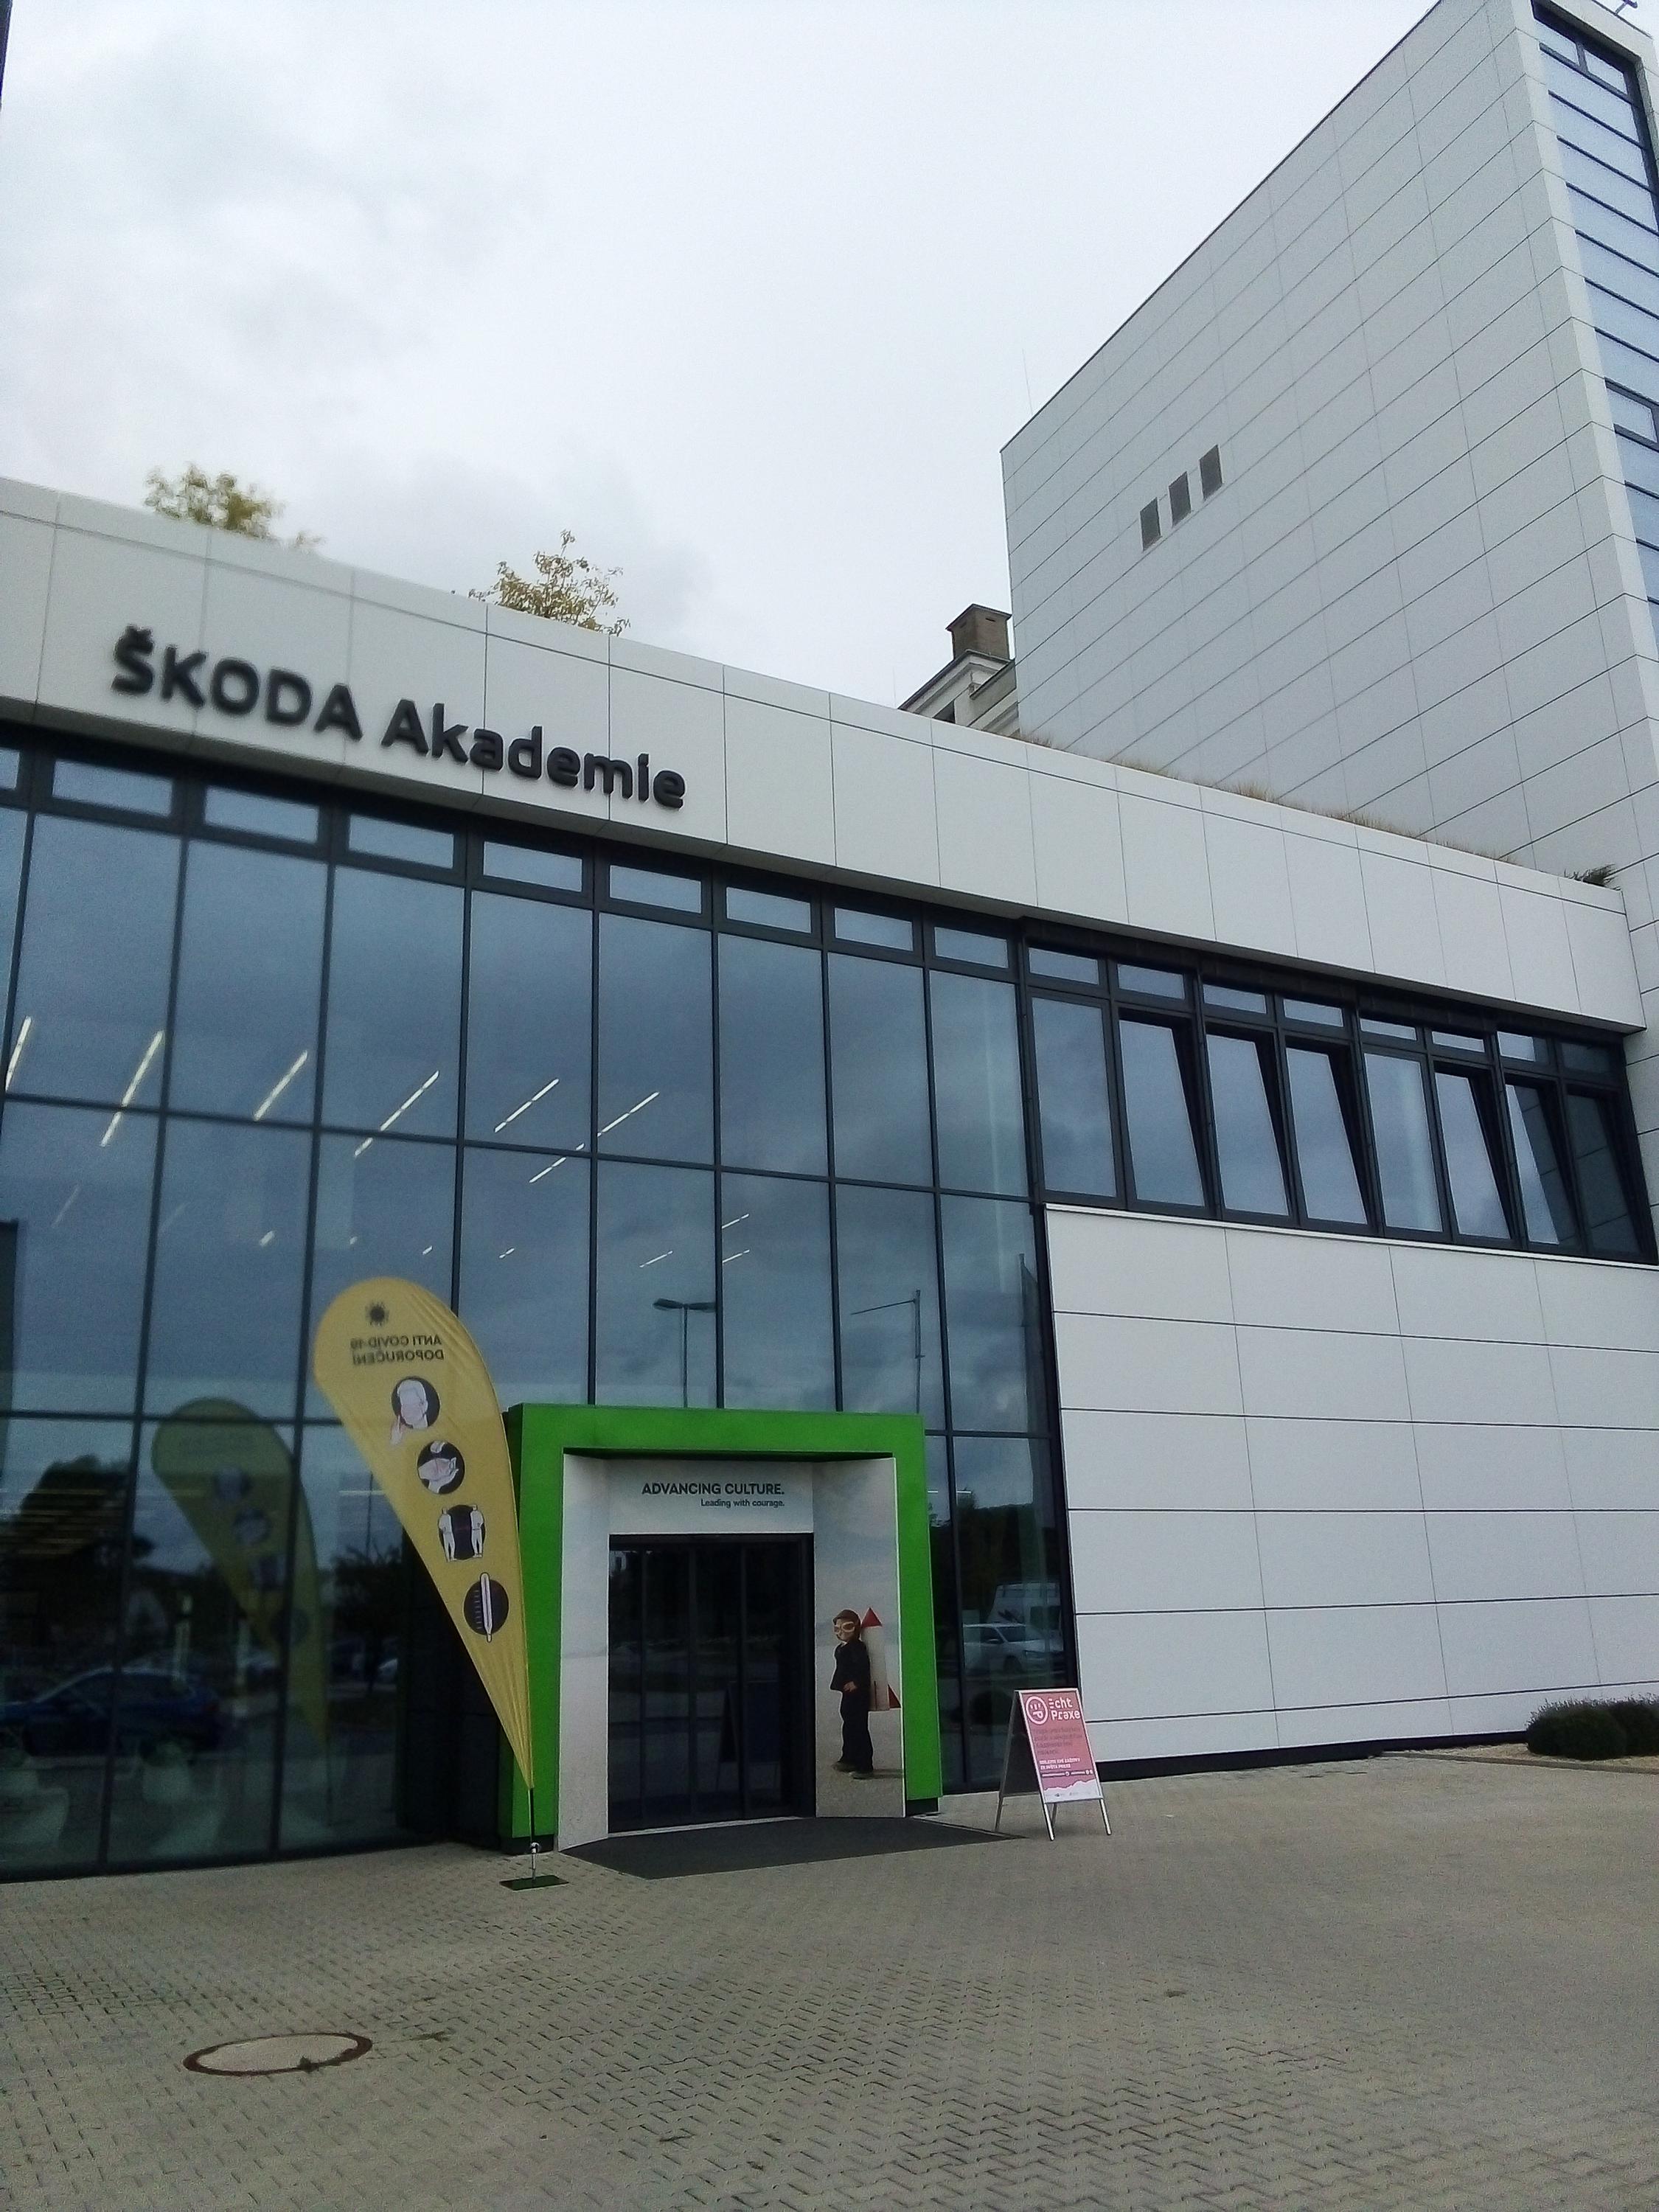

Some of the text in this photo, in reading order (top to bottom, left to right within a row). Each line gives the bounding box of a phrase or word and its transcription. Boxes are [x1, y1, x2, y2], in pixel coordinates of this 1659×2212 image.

[111, 625, 686, 810] ŠKODA Akademie
[641, 1483, 785, 1495] ADVANCING CULTURE.
[700, 1498, 785, 1509] Leading with courage.
[1050, 1710, 1081, 1721] Praxe
